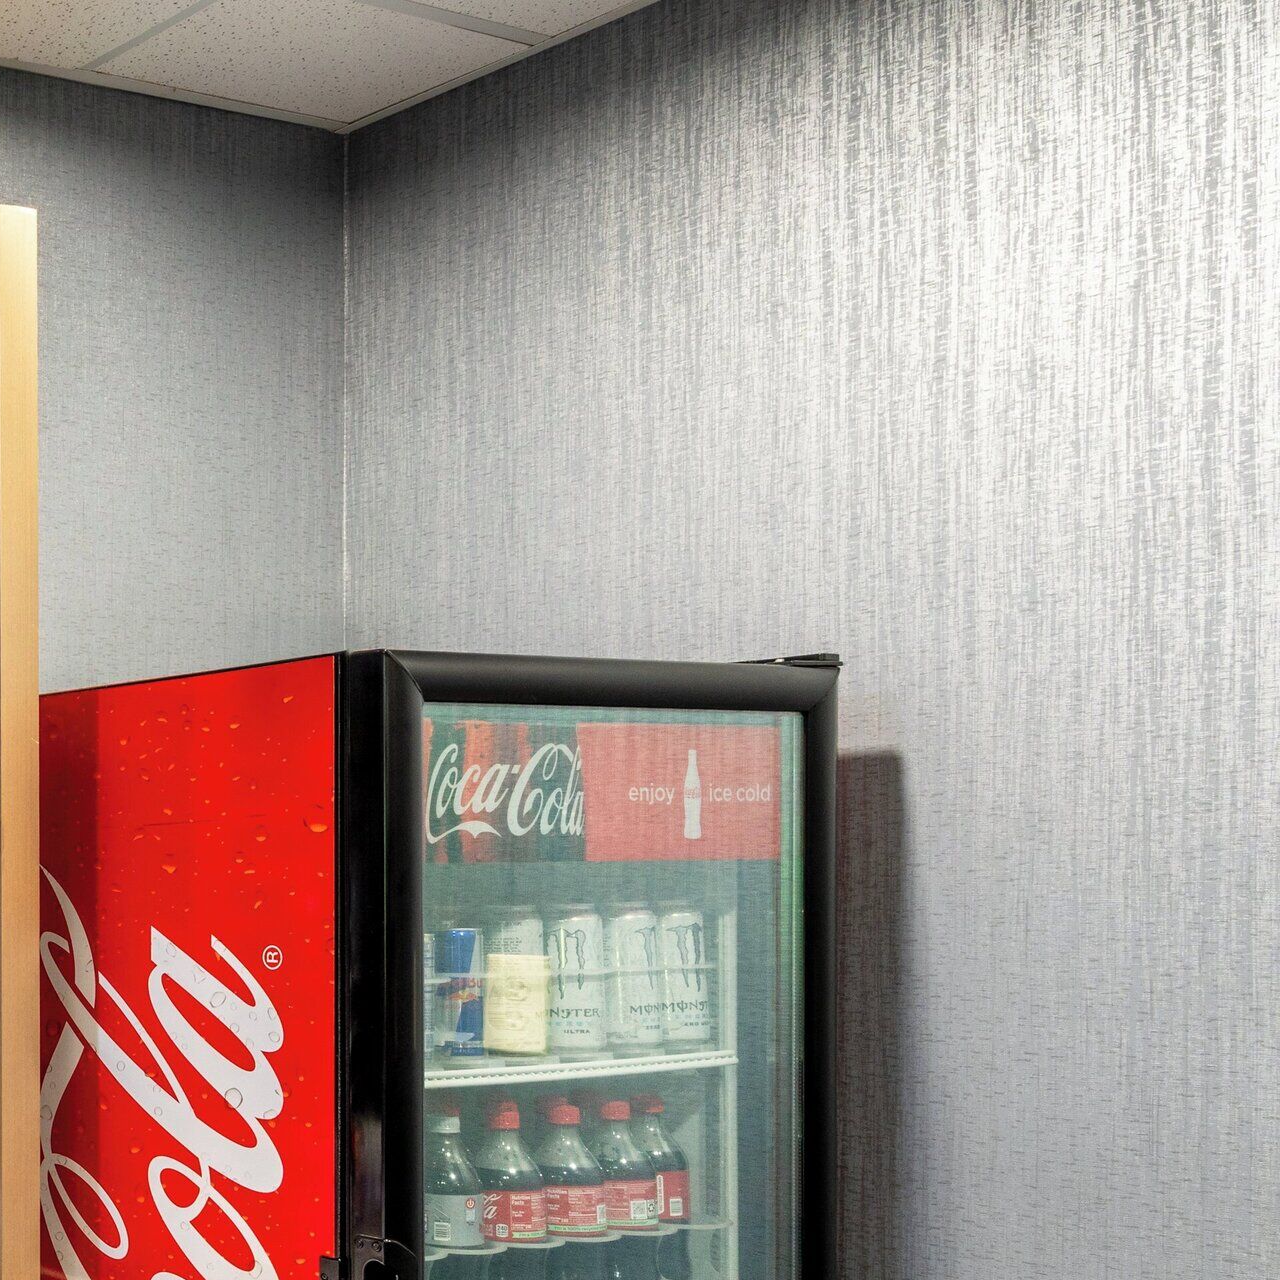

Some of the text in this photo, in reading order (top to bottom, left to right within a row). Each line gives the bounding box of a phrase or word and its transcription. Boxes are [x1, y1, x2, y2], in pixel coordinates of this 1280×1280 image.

[424, 742, 584, 845] Coca-Cola
[628, 784, 675, 805] enjoy
[709, 783, 771, 802] ice cold
